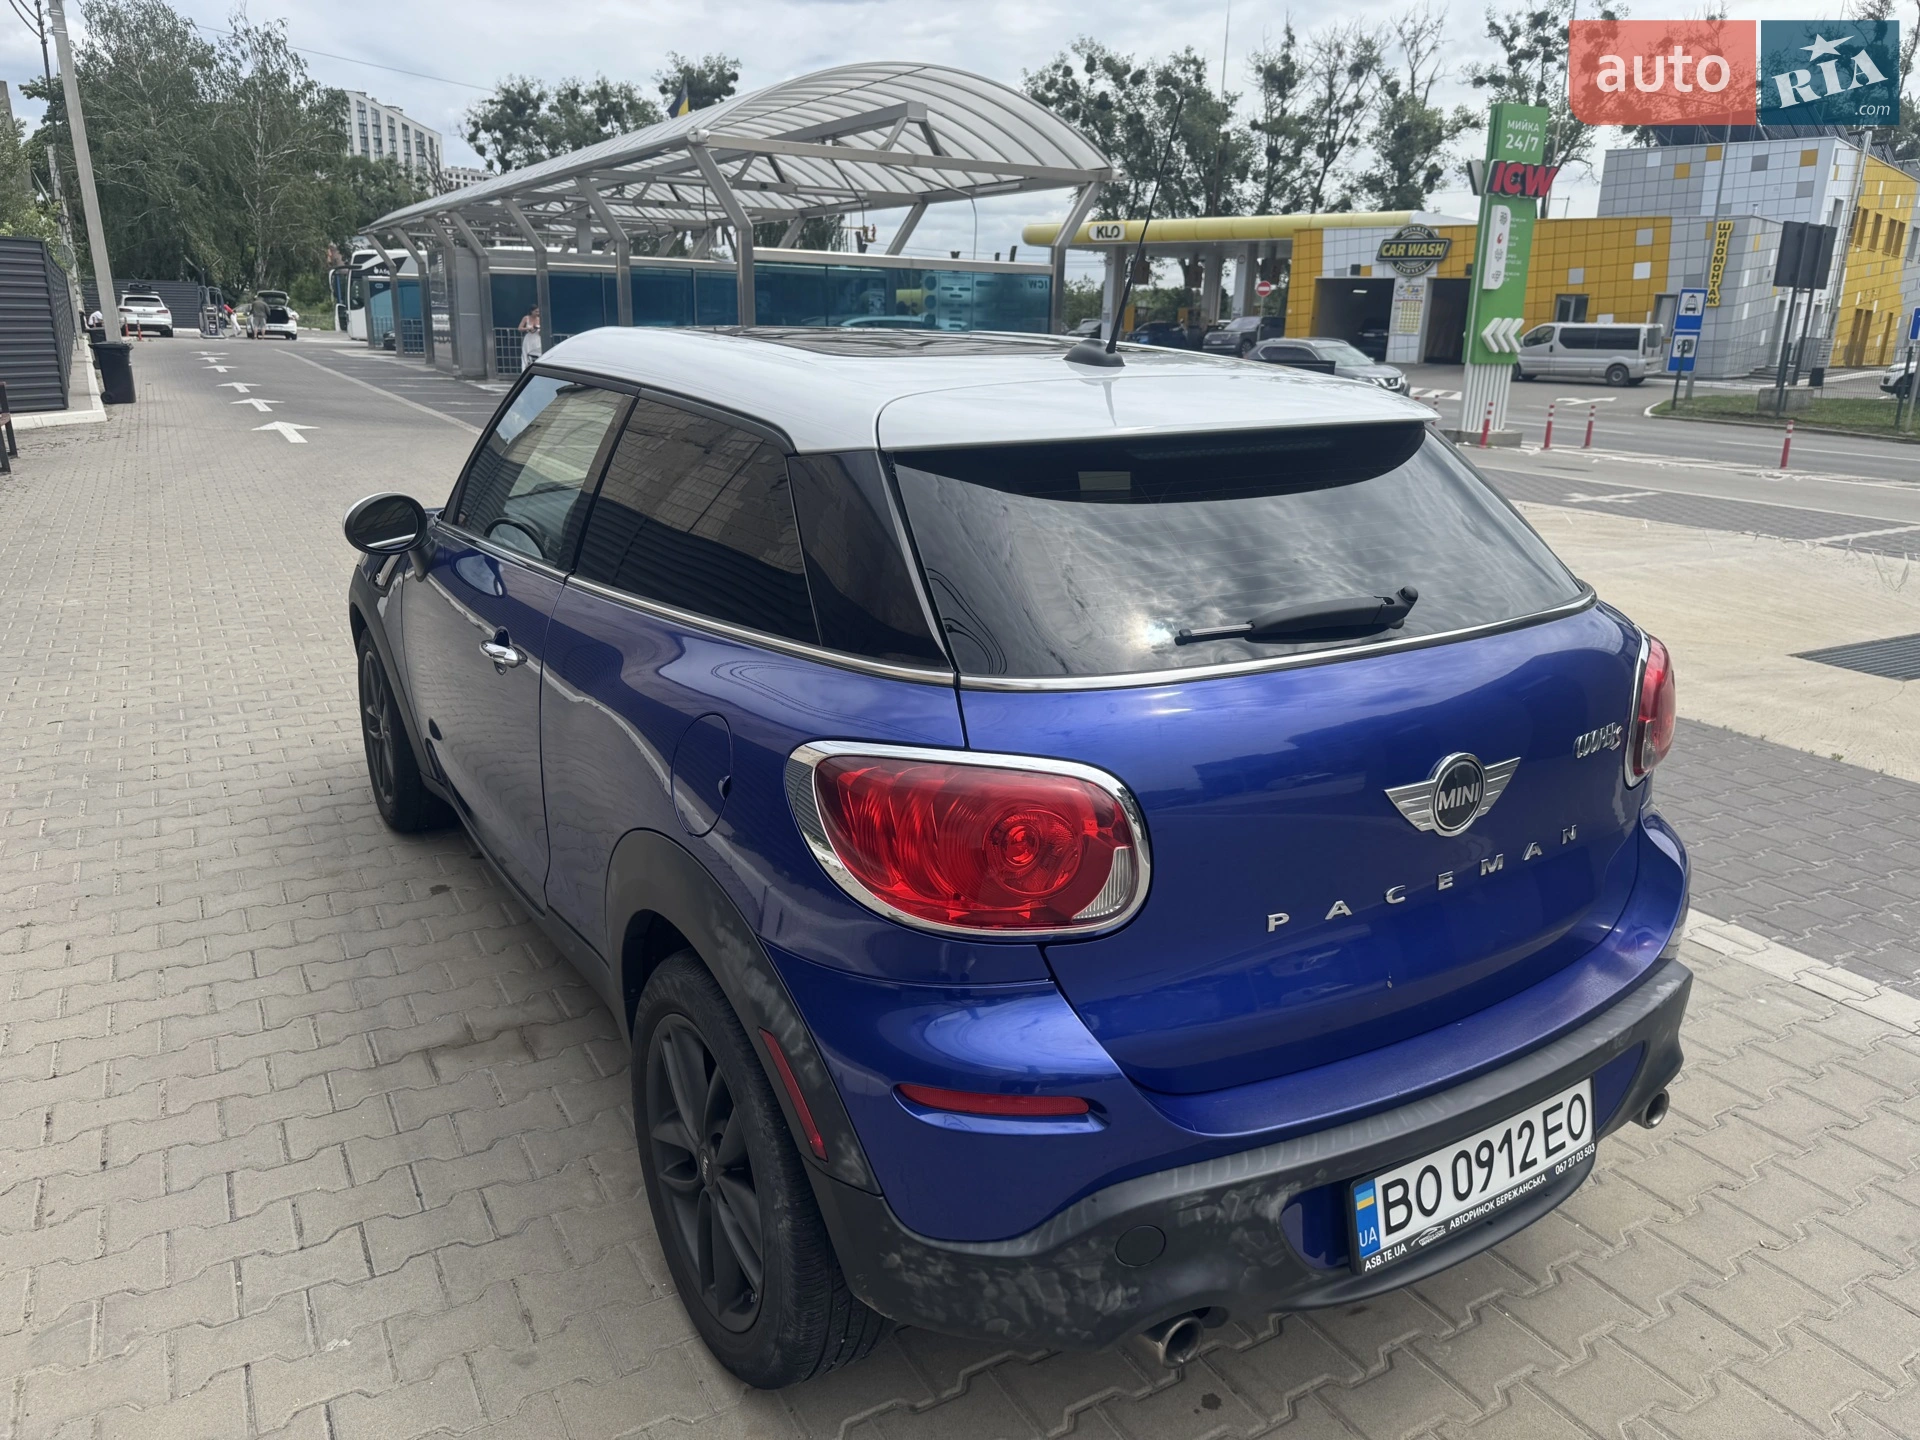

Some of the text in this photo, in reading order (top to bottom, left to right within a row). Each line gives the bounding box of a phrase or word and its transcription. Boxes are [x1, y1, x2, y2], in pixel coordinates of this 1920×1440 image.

[1507, 119, 1540, 132] МИЙКА
[1505, 133, 1539, 152] 24/7
[1492, 161, 1559, 196] ICW
[1096, 225, 1120, 239] KLO
[1381, 242, 1445, 257] CAR WASH
[1706, 222, 1731, 305] ШИНОМОНТАЖ
[1437, 782, 1481, 811] MINI
[1266, 824, 1578, 932] PACEMAN
[1382, 1093, 1587, 1236] BO 0912 EO
[1555, 1142, 1595, 1175] 067 27 03 503
[1449, 1174, 1547, 1230] АВТОРИНОК БЕРЕЖАНСЬКА
[1359, 1226, 1378, 1248] UA
[1364, 1243, 1407, 1272] ASB.TE.UA
